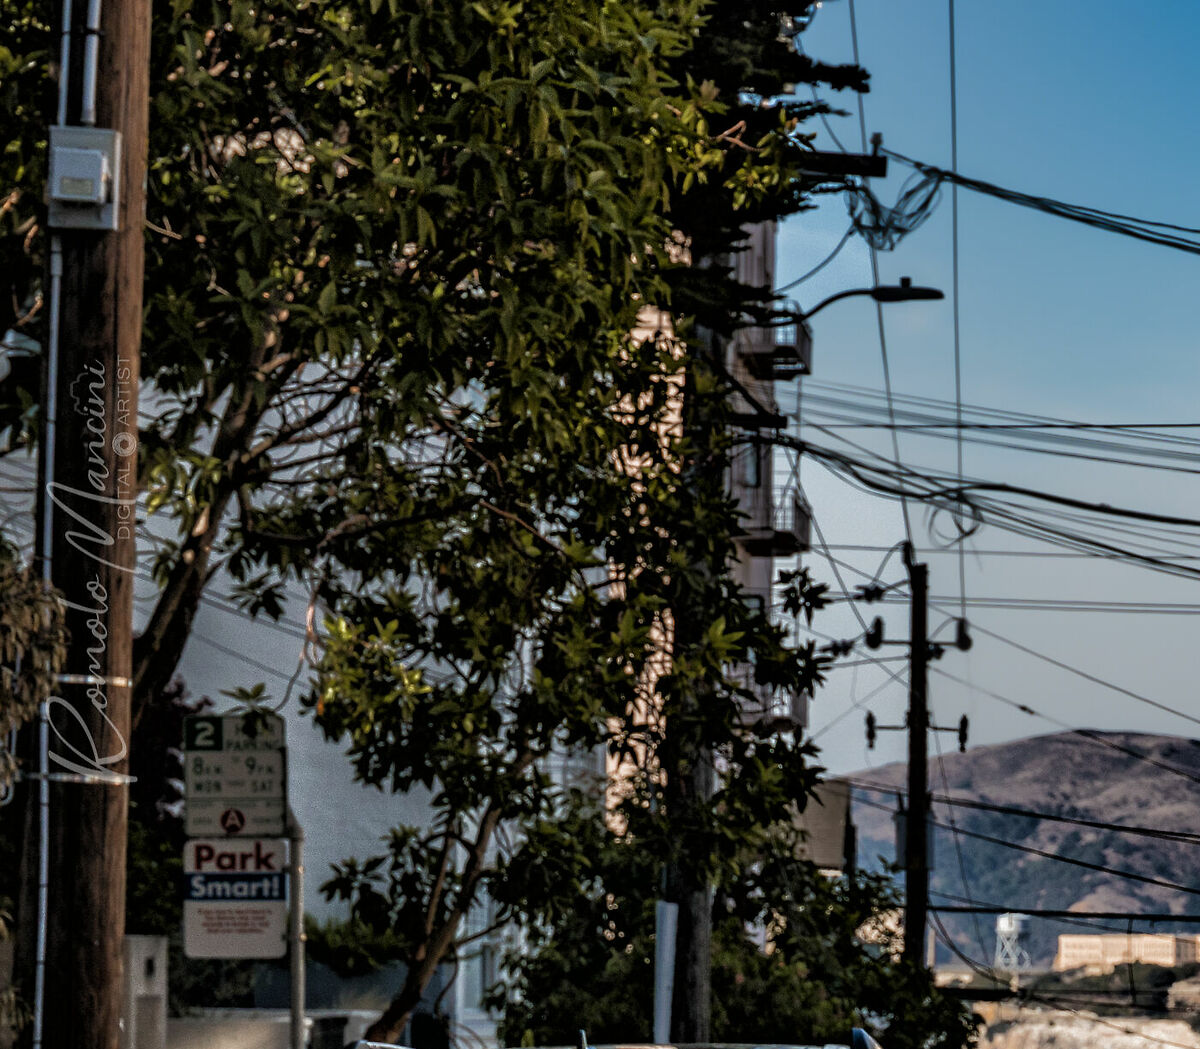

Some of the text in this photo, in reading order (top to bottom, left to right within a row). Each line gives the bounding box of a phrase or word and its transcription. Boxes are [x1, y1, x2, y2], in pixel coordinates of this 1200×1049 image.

[194, 722, 215, 746] 2
[194, 842, 275, 870] Park
[190, 875, 280, 897] Smart!
